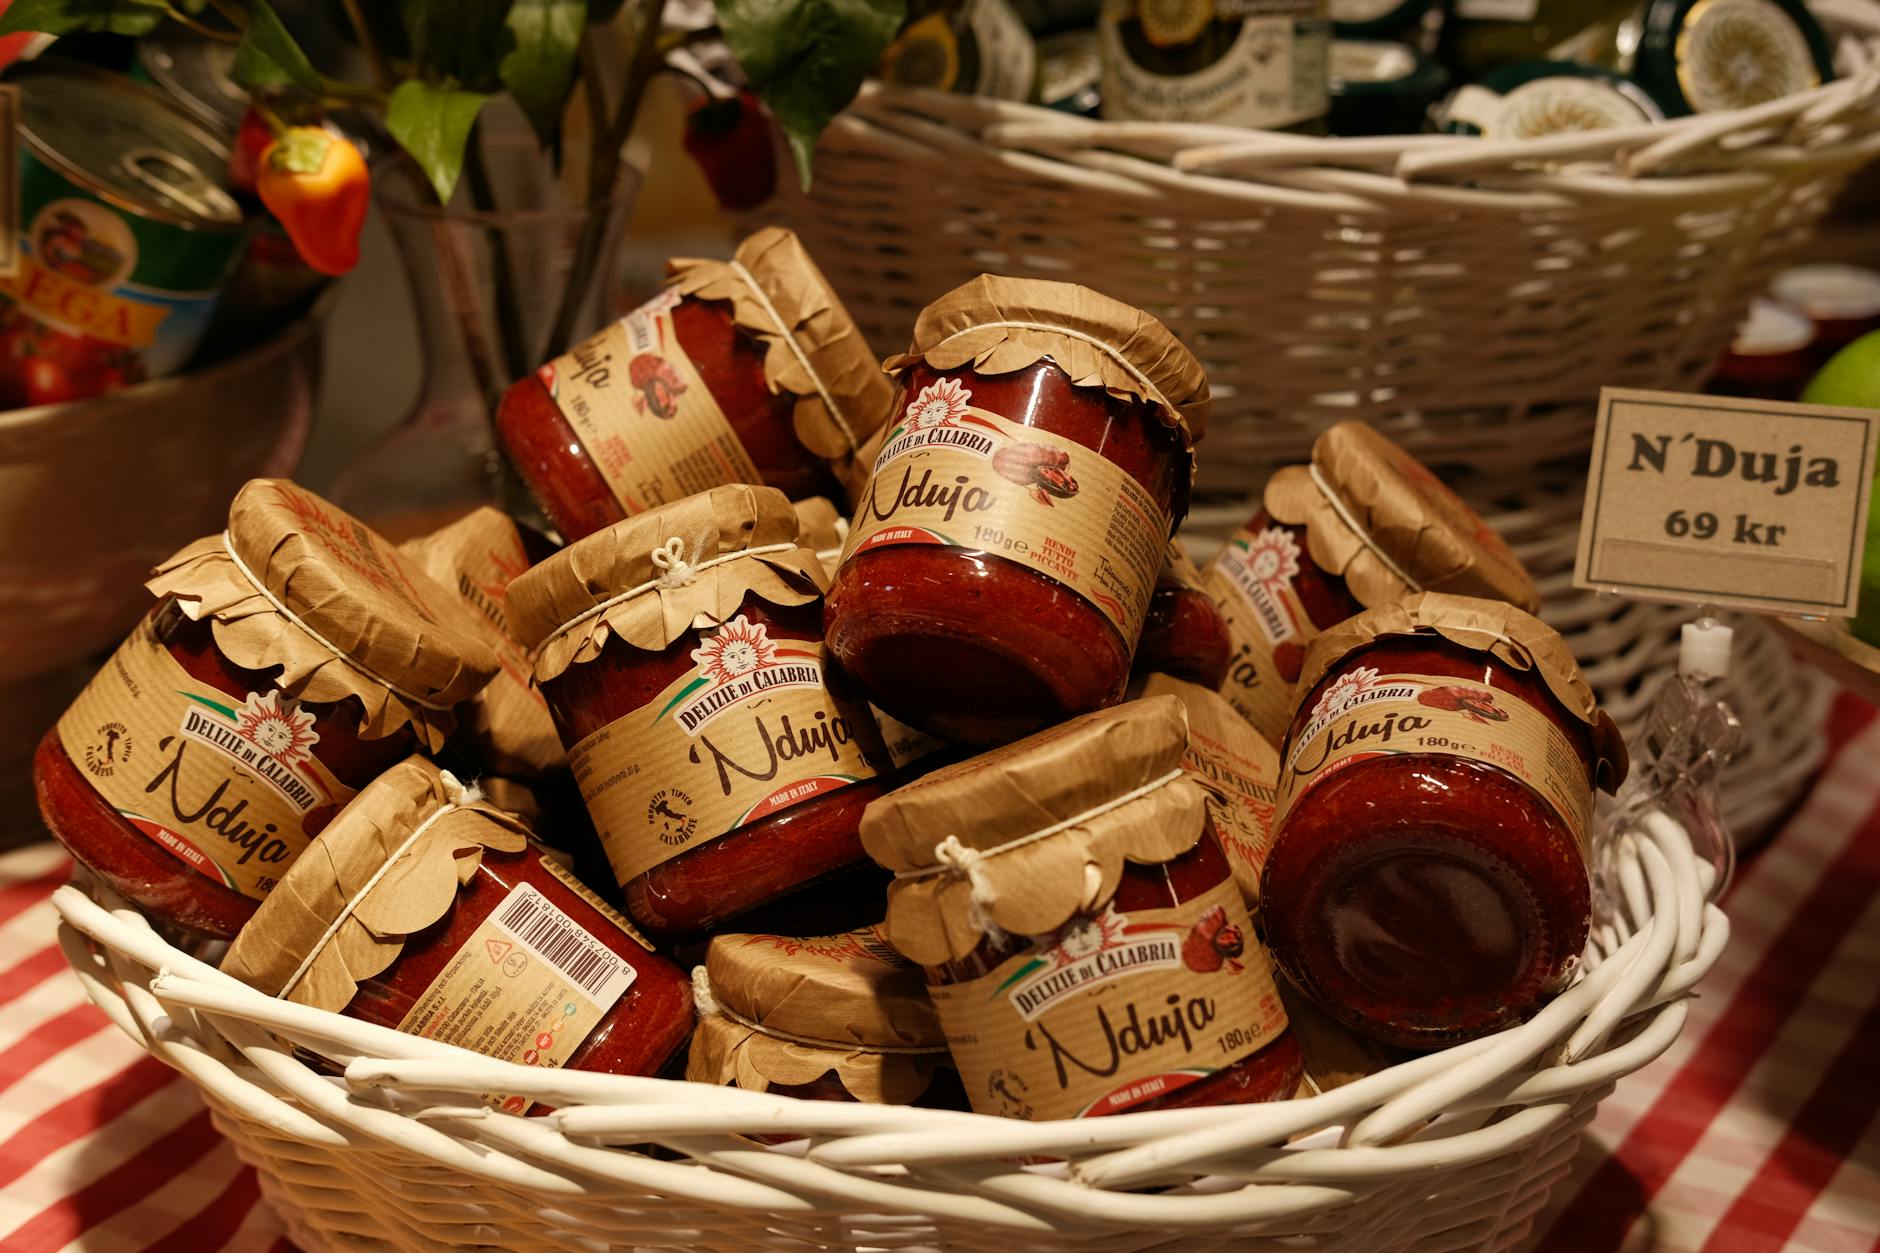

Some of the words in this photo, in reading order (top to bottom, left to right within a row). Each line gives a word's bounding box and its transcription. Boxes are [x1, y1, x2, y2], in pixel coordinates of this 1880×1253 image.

[24, 268, 132, 338] EGA
[914, 434, 924, 446] DI
[927, 428, 993, 455] CALABRIA
[871, 533, 885, 543] MADE
[893, 530, 913, 541] ITALY
[1665, 510, 1718, 539] 69
[1732, 514, 1786, 546] kr
[1041, 545, 1074, 568] TUTTO
[1044, 537, 1076, 559] RENDI
[1030, 551, 1079, 580] PICCANTE
[680, 684, 739, 731] DELIZIE
[739, 680, 752, 694] DI
[753, 667, 819, 690] CALABRIA
[1343, 688, 1414, 710] CALABRIA
[97, 721, 127, 735] PRODOTTO
[86, 746, 114, 777] CALABRESE
[122, 737, 132, 762] TIPICO
[185, 711, 245, 754] DELIZIE
[241, 747, 257, 763] DI
[257, 755, 316, 810] CALABRIA
[648, 790, 667, 824] PRODOTTO
[671, 789, 693, 806] TIPICO
[770, 790, 789, 807] MADE
[789, 787, 798, 799] IN
[798, 781, 818, 796] ITALY
[659, 818, 698, 846] CALABRESE
[157, 829, 179, 847] MADE
[183, 847, 206, 865] ITALY
[469, 975, 485, 994] ITALIA
[1015, 967, 1079, 1014] DELIZIE
[1079, 964, 1095, 980] DI
[1096, 942, 1177, 973] CALABRIA
[1108, 1090, 1132, 1106] MADE
[1141, 1078, 1166, 1096] ITALY
